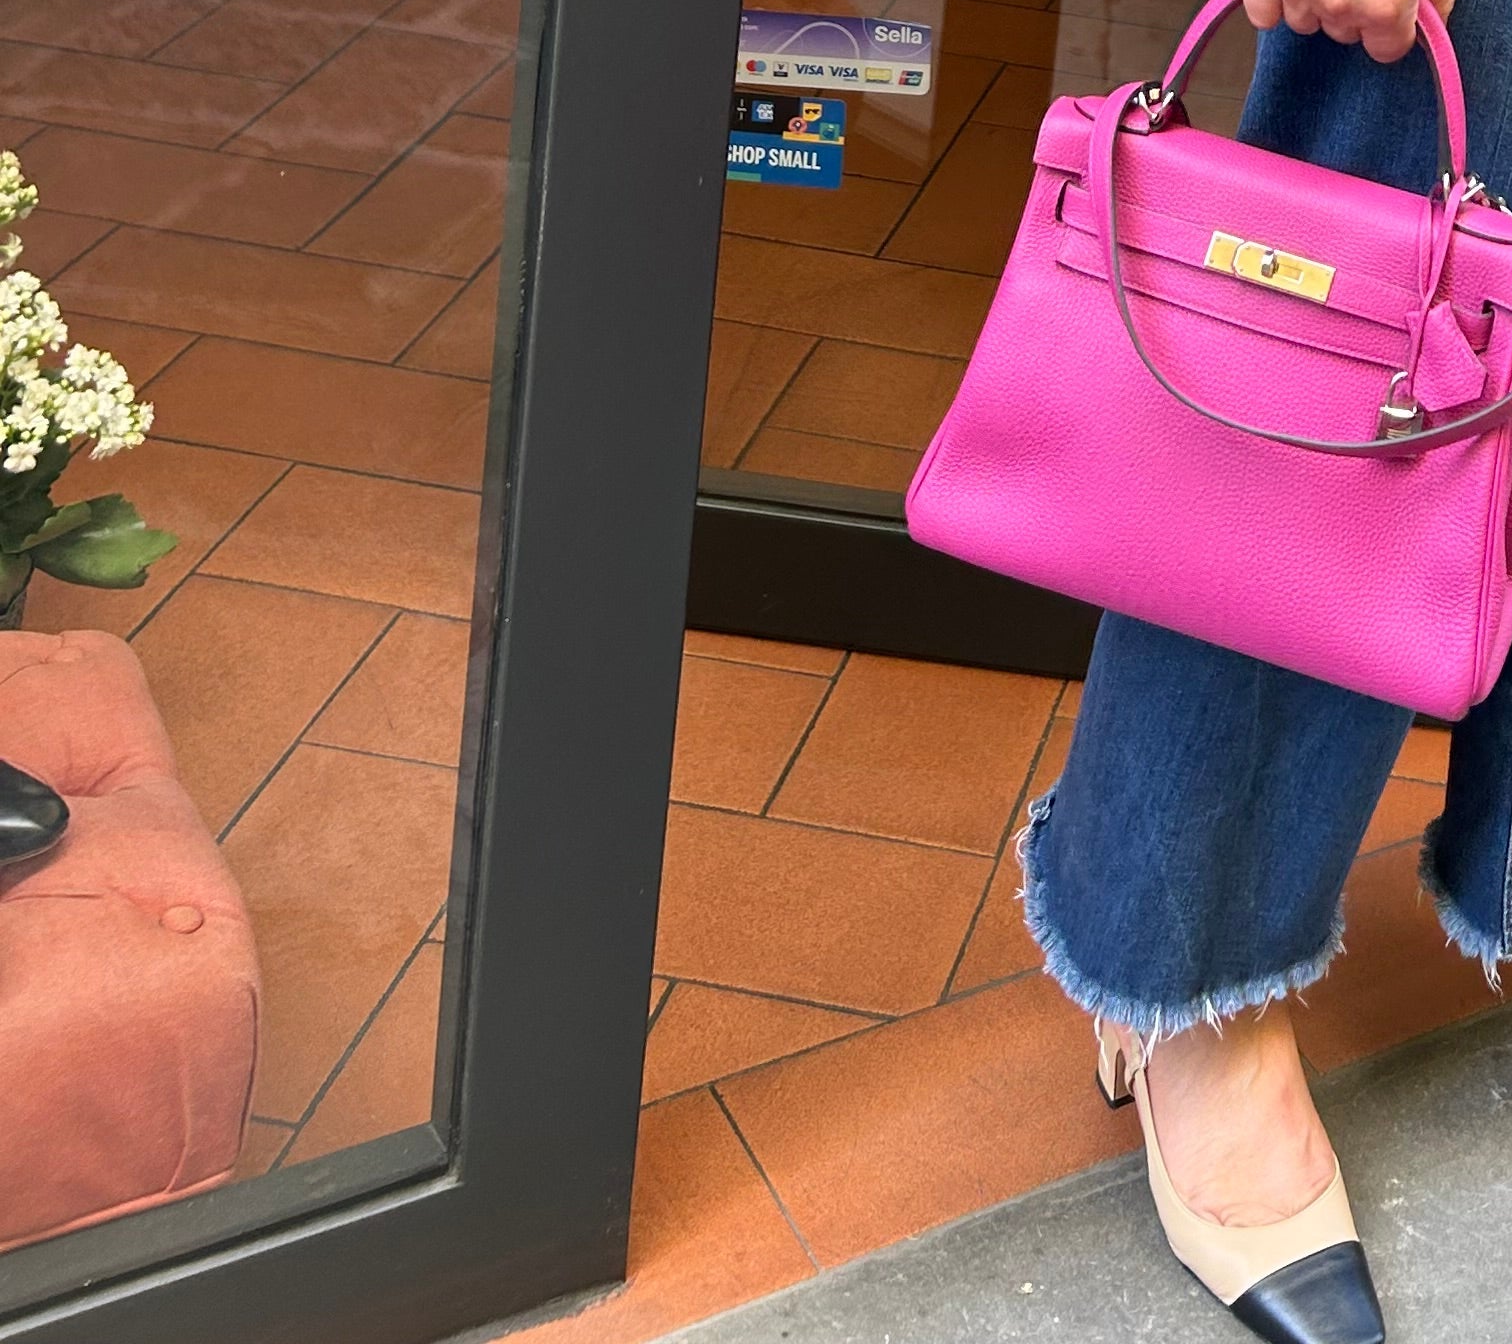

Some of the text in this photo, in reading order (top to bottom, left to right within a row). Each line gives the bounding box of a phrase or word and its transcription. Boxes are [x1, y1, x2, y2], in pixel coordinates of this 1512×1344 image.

[874, 25, 923, 44] Sella
[795, 63, 859, 78] VISA VISA
[768, 148, 821, 171] SMALL
